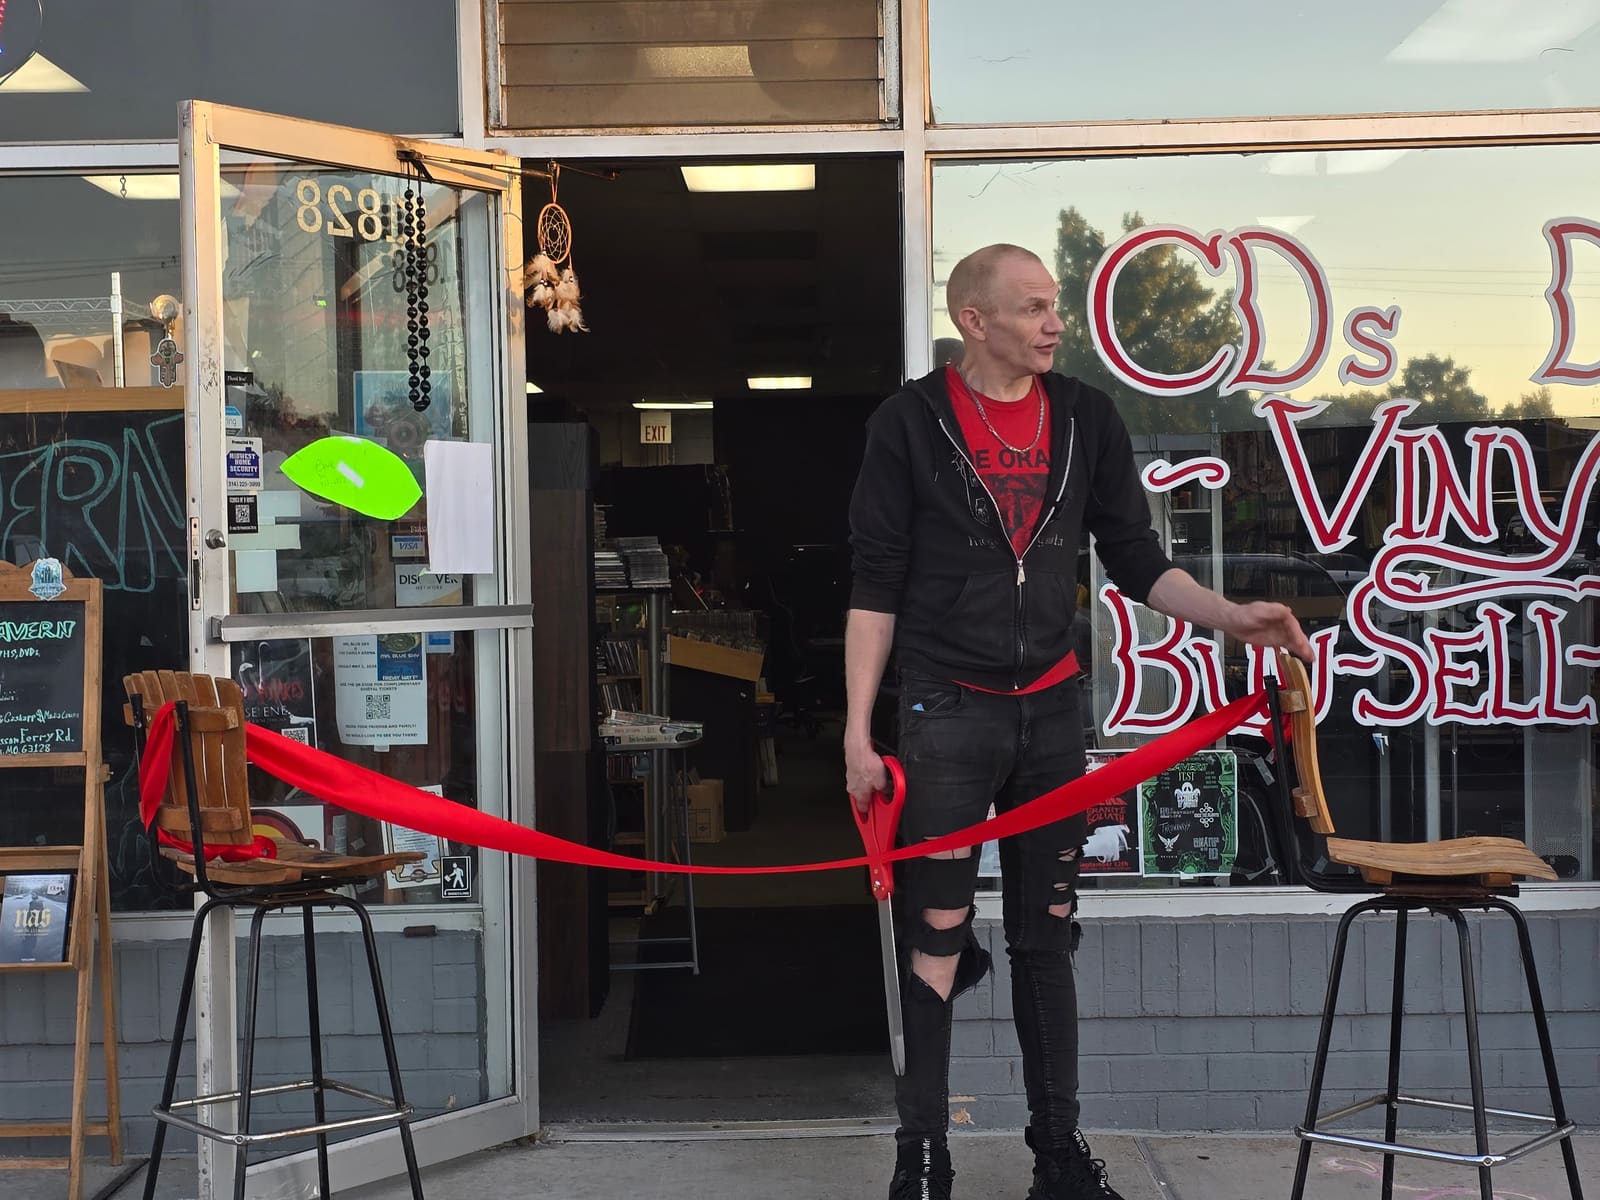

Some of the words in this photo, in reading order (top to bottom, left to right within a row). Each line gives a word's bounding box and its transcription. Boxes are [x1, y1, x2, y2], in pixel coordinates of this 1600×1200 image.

[1087, 223, 1401, 397] CDs
[645, 425, 667, 441] EXIT
[399, 574, 458, 585] DISVER
[21, 743, 51, 753] 63128
[15, 908, 52, 928] nas
